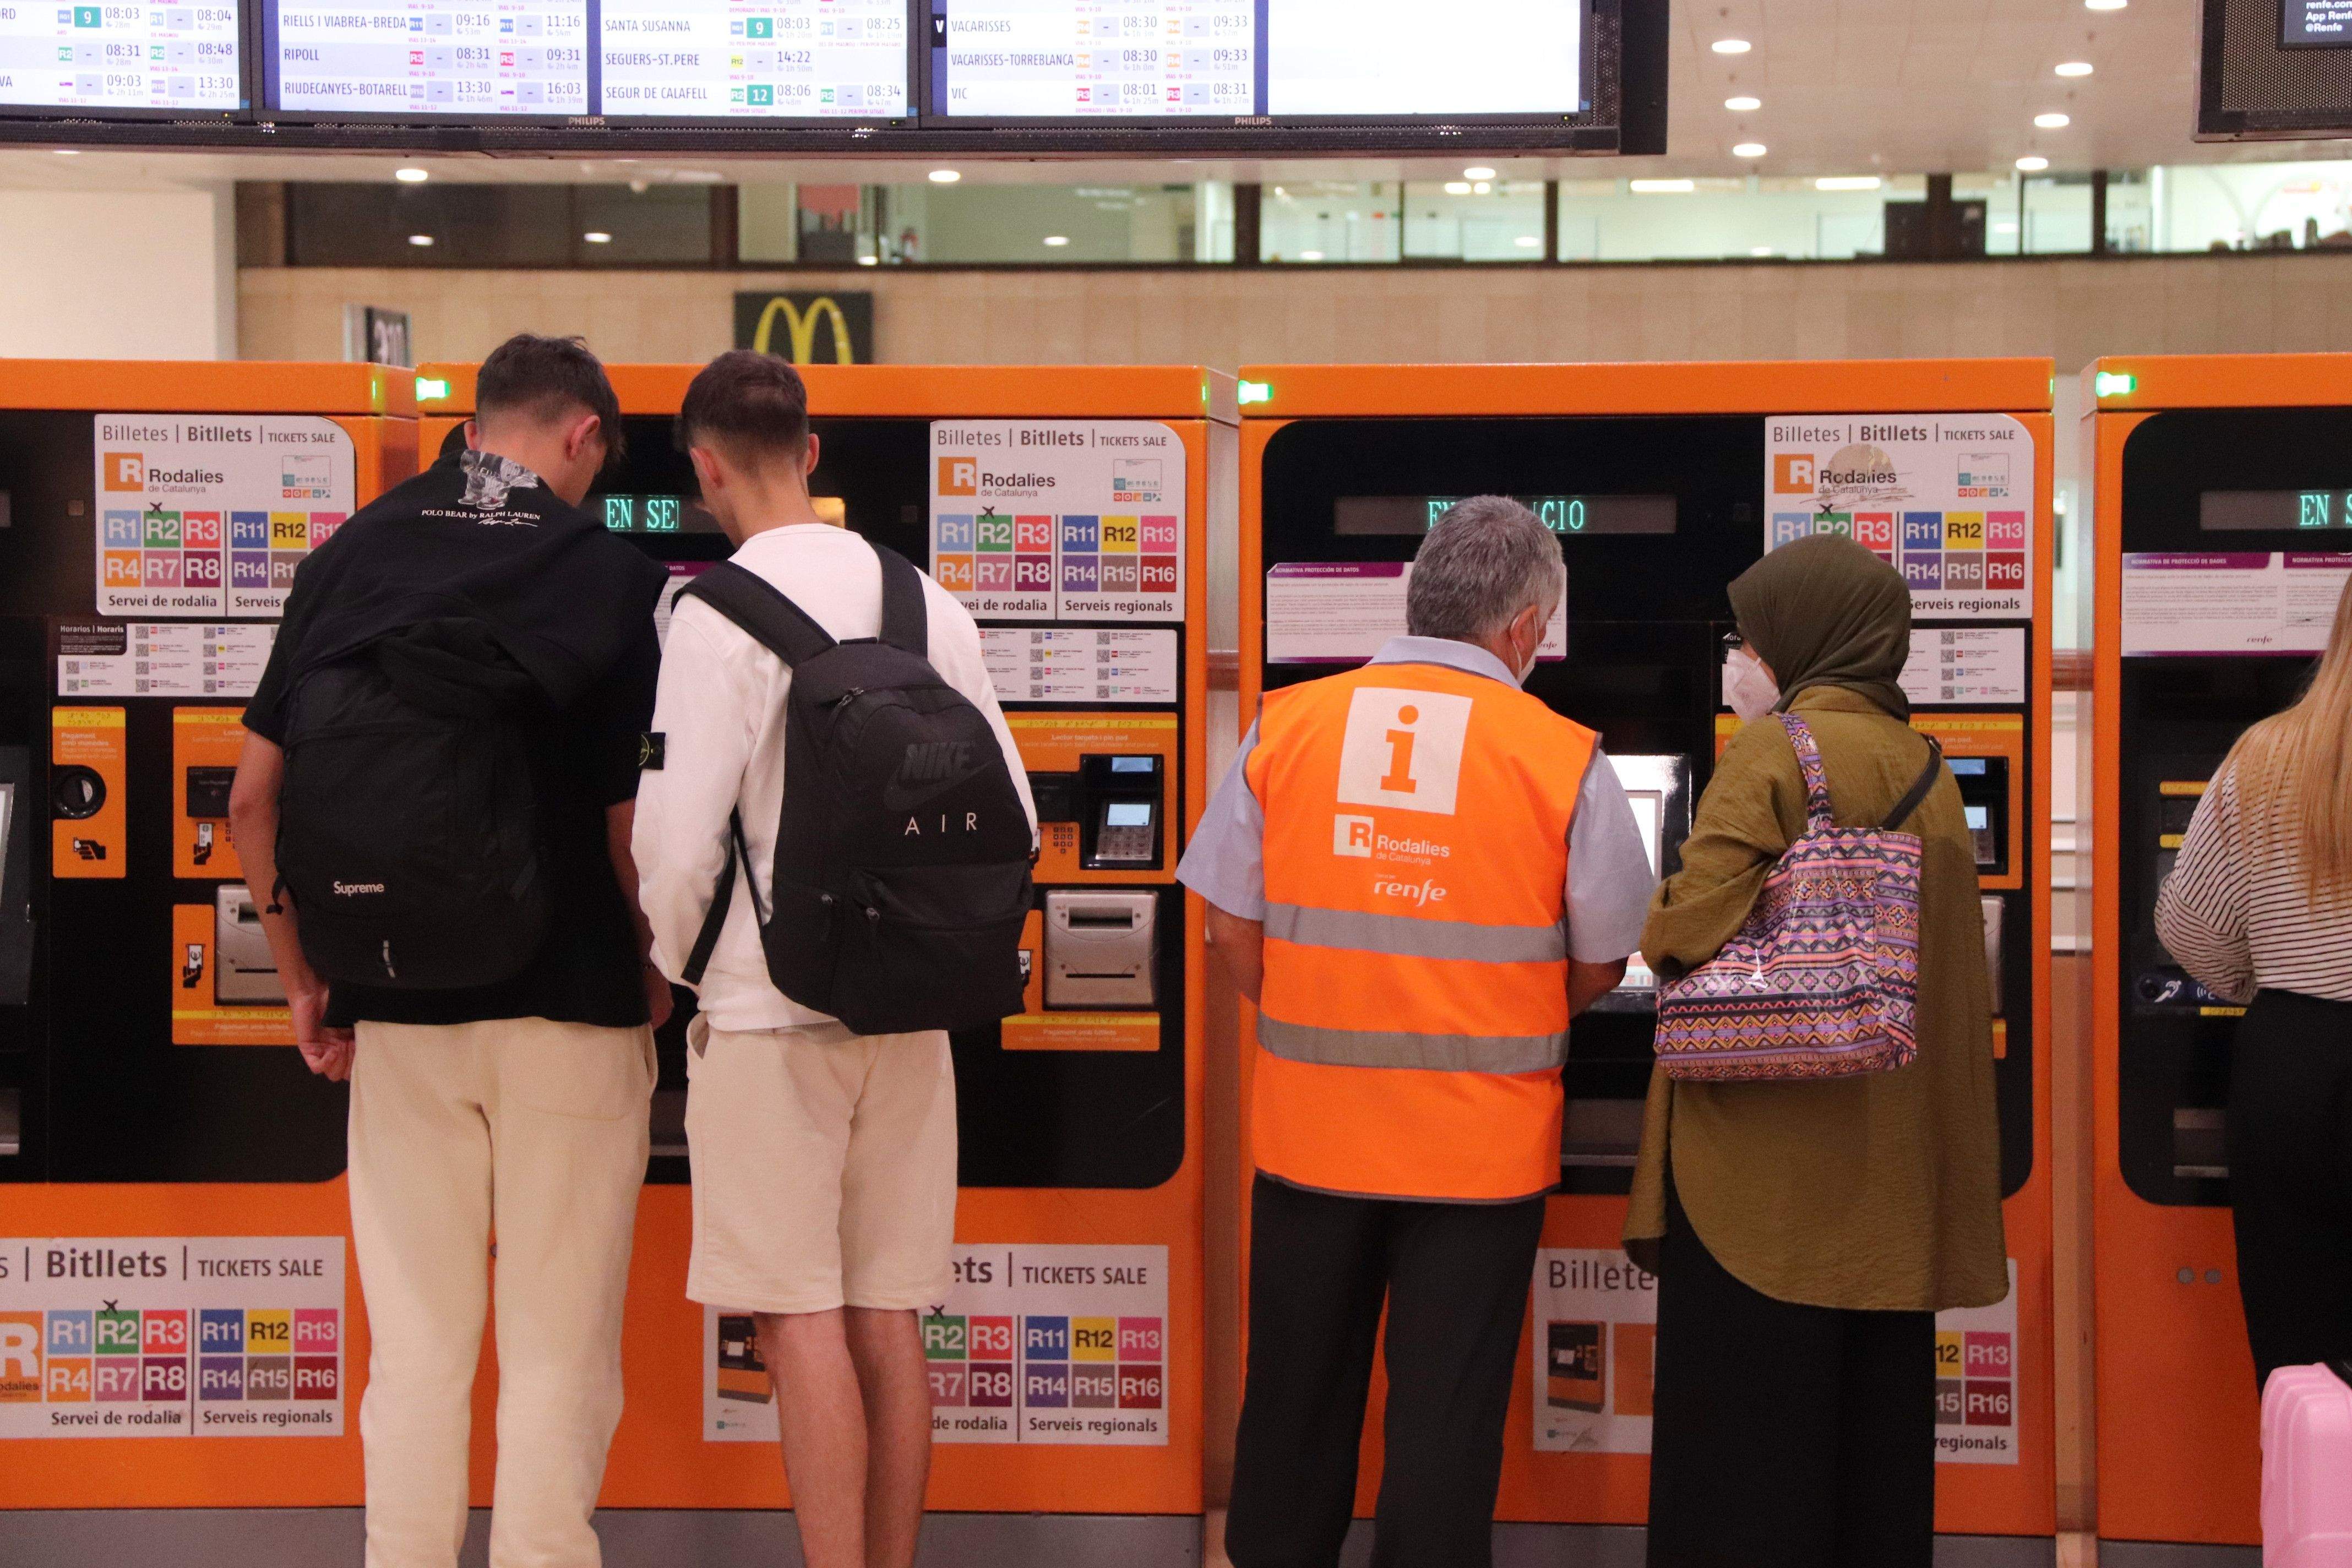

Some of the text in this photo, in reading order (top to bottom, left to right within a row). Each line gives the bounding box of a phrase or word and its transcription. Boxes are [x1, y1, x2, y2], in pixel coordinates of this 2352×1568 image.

[84, 11, 92, 24] 9
[106, 7, 139, 19] 08:03
[197, 9, 232, 21] 08:04
[2306, 12, 2326, 22] App
[284, 15, 314, 26] RIELLS
[325, 16, 406, 28] VIABREA-BREDA
[456, 14, 489, 26] 09:16
[547, 15, 580, 27] 11:16
[606, 20, 690, 31] SANTA SUSANNA
[777, 18, 810, 29] 08:03
[867, 18, 900, 29] 08:25
[935, 20, 944, 32] V
[1123, 17, 1157, 28] 08:30
[1214, 15, 1247, 27] 09:33
[756, 22, 764, 35] 9
[951, 21, 1011, 32] VACARISSES
[2306, 23, 2343, 32] @Renfe
[106, 44, 140, 56] 08:31
[198, 43, 232, 55] 08:48
[285, 48, 319, 61] RIPOLL
[457, 48, 490, 59] 08:31
[547, 49, 580, 61] 09:31
[1214, 49, 1247, 61] 09:33
[606, 53, 700, 66] SEGUERS-ST.PERE
[777, 51, 810, 62] 14:22
[951, 54, 1074, 66] VACARISSES-TORREBLANCA
[1123, 50, 1157, 61] 08:30
[107, 75, 141, 86] 09:03
[199, 77, 233, 89] 13:30
[285, 83, 407, 95] RIUDECANYES-BOTARELL
[458, 81, 491, 93] 13:30
[548, 83, 580, 94] 16:03
[606, 87, 707, 99] SEGUR DE CALAFELL
[777, 85, 810, 96] 08:06
[867, 85, 900, 96] 08:34
[1123, 84, 1157, 95] 08:01
[1214, 83, 1247, 95] 08:31
[753, 89, 767, 101] 12
[951, 88, 967, 99] VIC
[568, 117, 605, 125] PHILIPS
[1235, 117, 1271, 125] PHILIPS
[103, 425, 335, 443] Billetes Bitllets TICKETS SALE
[938, 430, 1166, 446] Billetes Bitllets TICKETS SALE
[1773, 426, 2015, 442] Billetes Bitllets TICKETS SALE
[119, 459, 224, 483] R Rodalies
[954, 462, 1055, 487] R Rodalies
[1790, 460, 1896, 484] R Rodalies
[162, 484, 206, 494] Catalunya
[994, 488, 1037, 498] Catalunya
[1833, 486, 1878, 494] Catalunya
[508, 511, 541, 520] LAUREN
[606, 499, 679, 529] EN SE
[2300, 494, 2330, 525] EN
[108, 519, 306, 540] R1 R2 R3 R11 R12
[941, 523, 1175, 543] R1 R2 R3 R11 R12 R13
[107, 559, 266, 579] R4 R7 R8 R14
[108, 596, 280, 607] Servei de rodalia Serveis
[984, 599, 999, 611] de
[1003, 599, 1047, 611] rodalia
[1065, 601, 1110, 611] Serveis
[1114, 601, 1173, 614] regionals
[1959, 598, 2020, 612] regionals
[2247, 635, 2273, 644] renfe
[899, 743, 970, 779] NIKE
[1349, 821, 1451, 857] R Rodalies
[1376, 852, 1431, 866] de Catalunya
[334, 881, 384, 896] Supreme
[1374, 879, 1447, 907] renfe
[47, 1249, 323, 1278] Bitllets TICKETS SALE
[1023, 1267, 1147, 1284] TICKETS SALE
[52, 1410, 333, 1427] Servei de rodalia Serveis regionals
[932, 1416, 1157, 1434] de rodalia Serveis regionals
